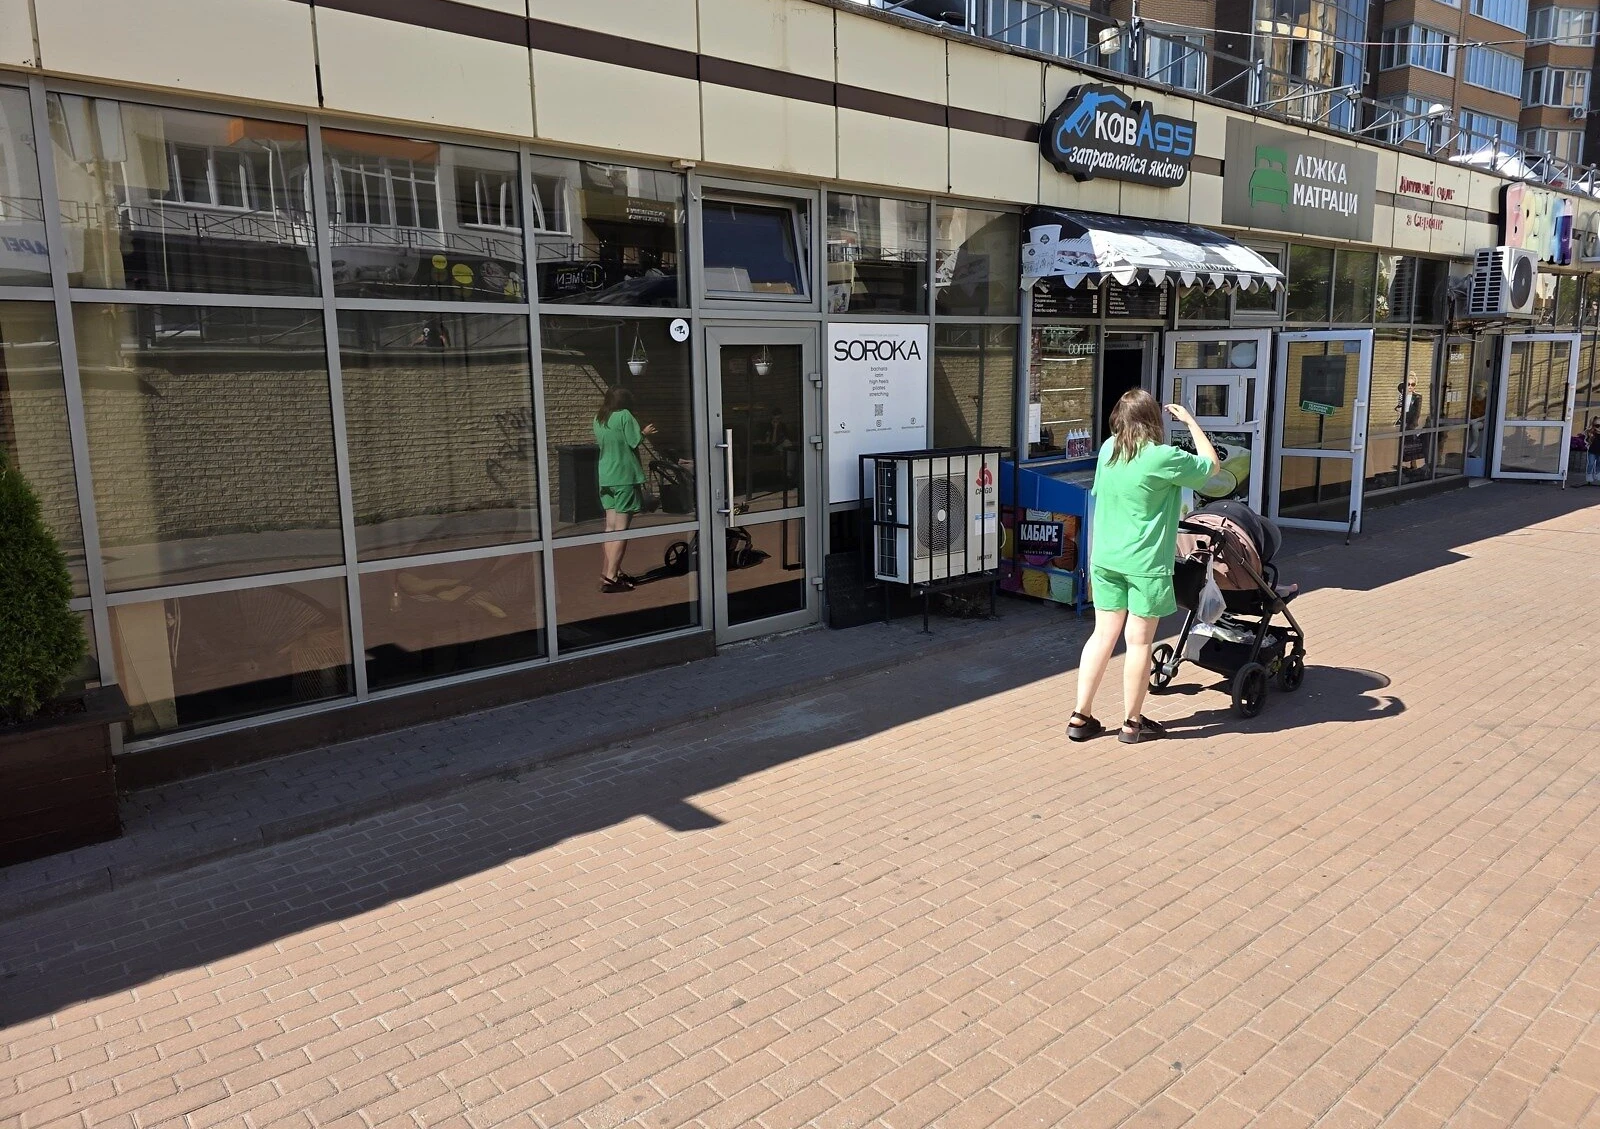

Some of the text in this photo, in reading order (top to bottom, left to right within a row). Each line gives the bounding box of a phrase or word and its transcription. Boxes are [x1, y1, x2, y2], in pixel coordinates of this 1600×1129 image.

[1069, 146, 1184, 180] заправляйся якісно
[1294, 154, 1347, 185] ЛІЖКА
[1293, 183, 1358, 217] МАТРАЦИ
[833, 339, 922, 362] SOROKA
[1068, 343, 1096, 355] COFFEE
[975, 486, 993, 496] CHGO
[1020, 523, 1059, 542] КАБАРЕ
